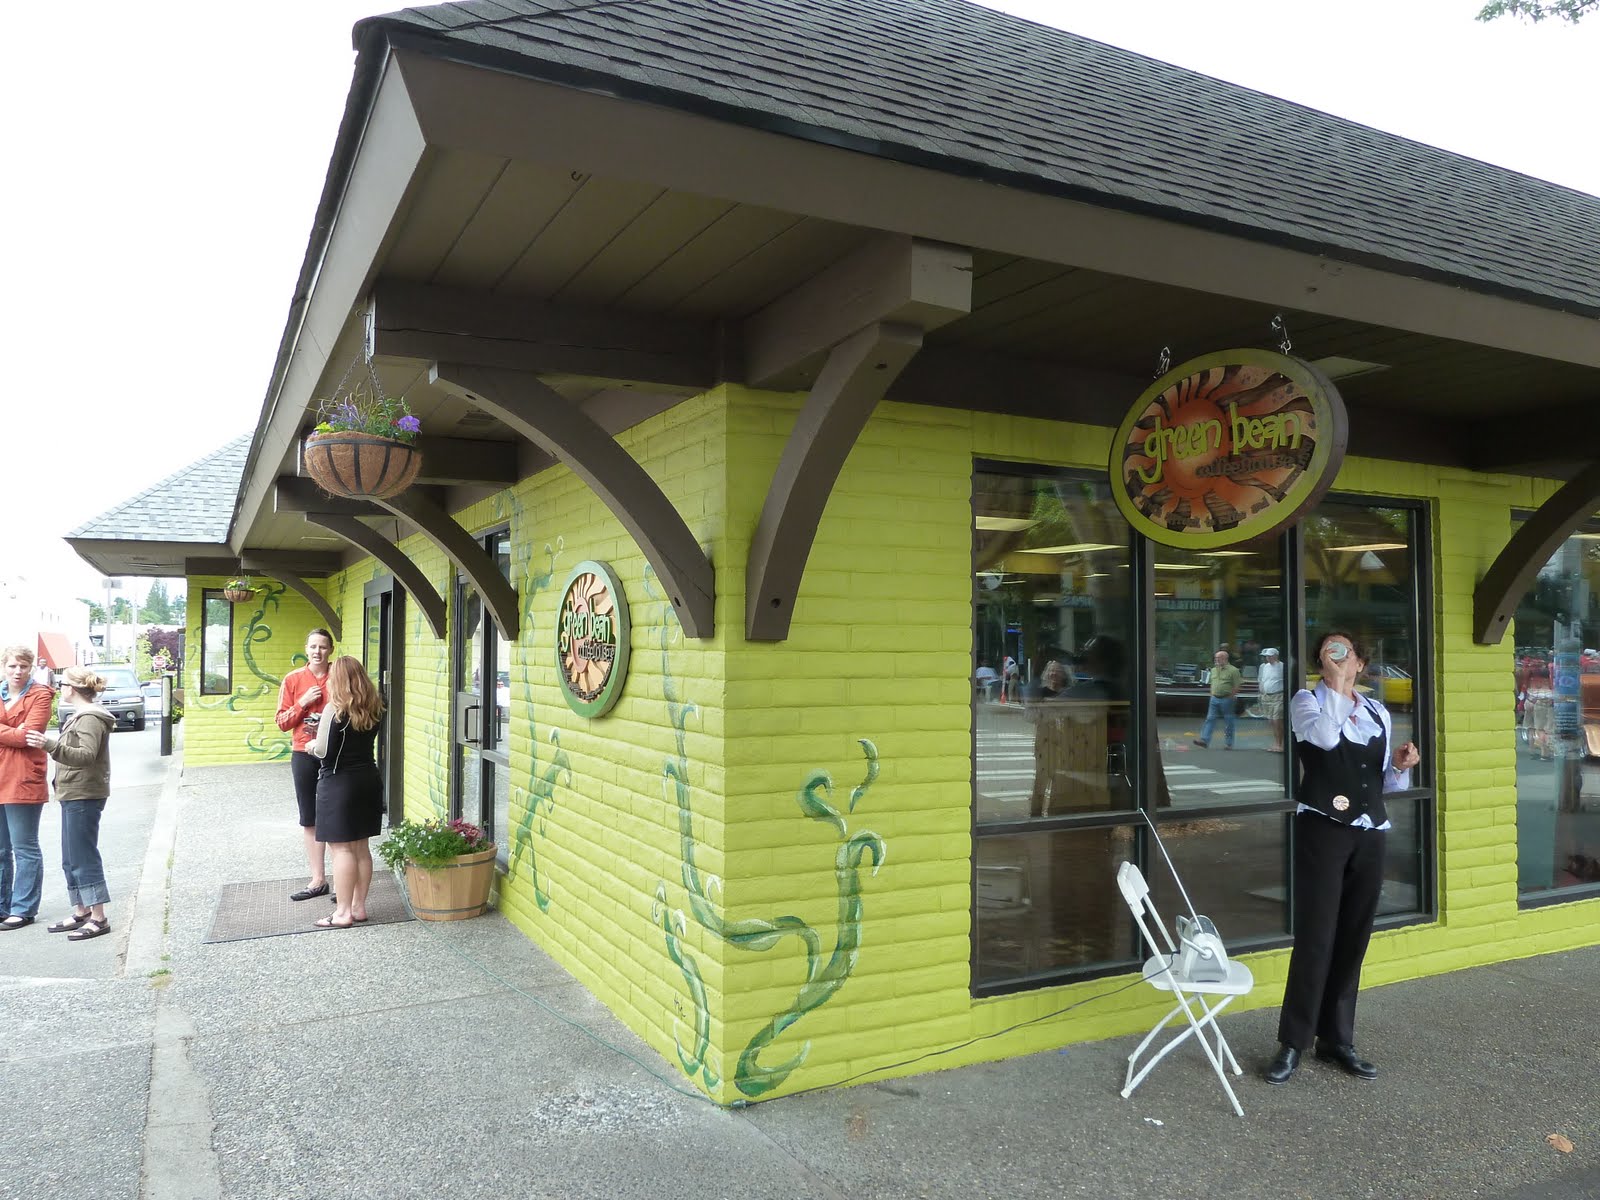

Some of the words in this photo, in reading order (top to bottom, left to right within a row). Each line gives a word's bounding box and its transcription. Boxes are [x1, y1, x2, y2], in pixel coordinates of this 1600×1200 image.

[1137, 416, 1222, 484] green
[1229, 401, 1301, 455] bean
[560, 601, 588, 652] green
[589, 597, 610, 645] bean
